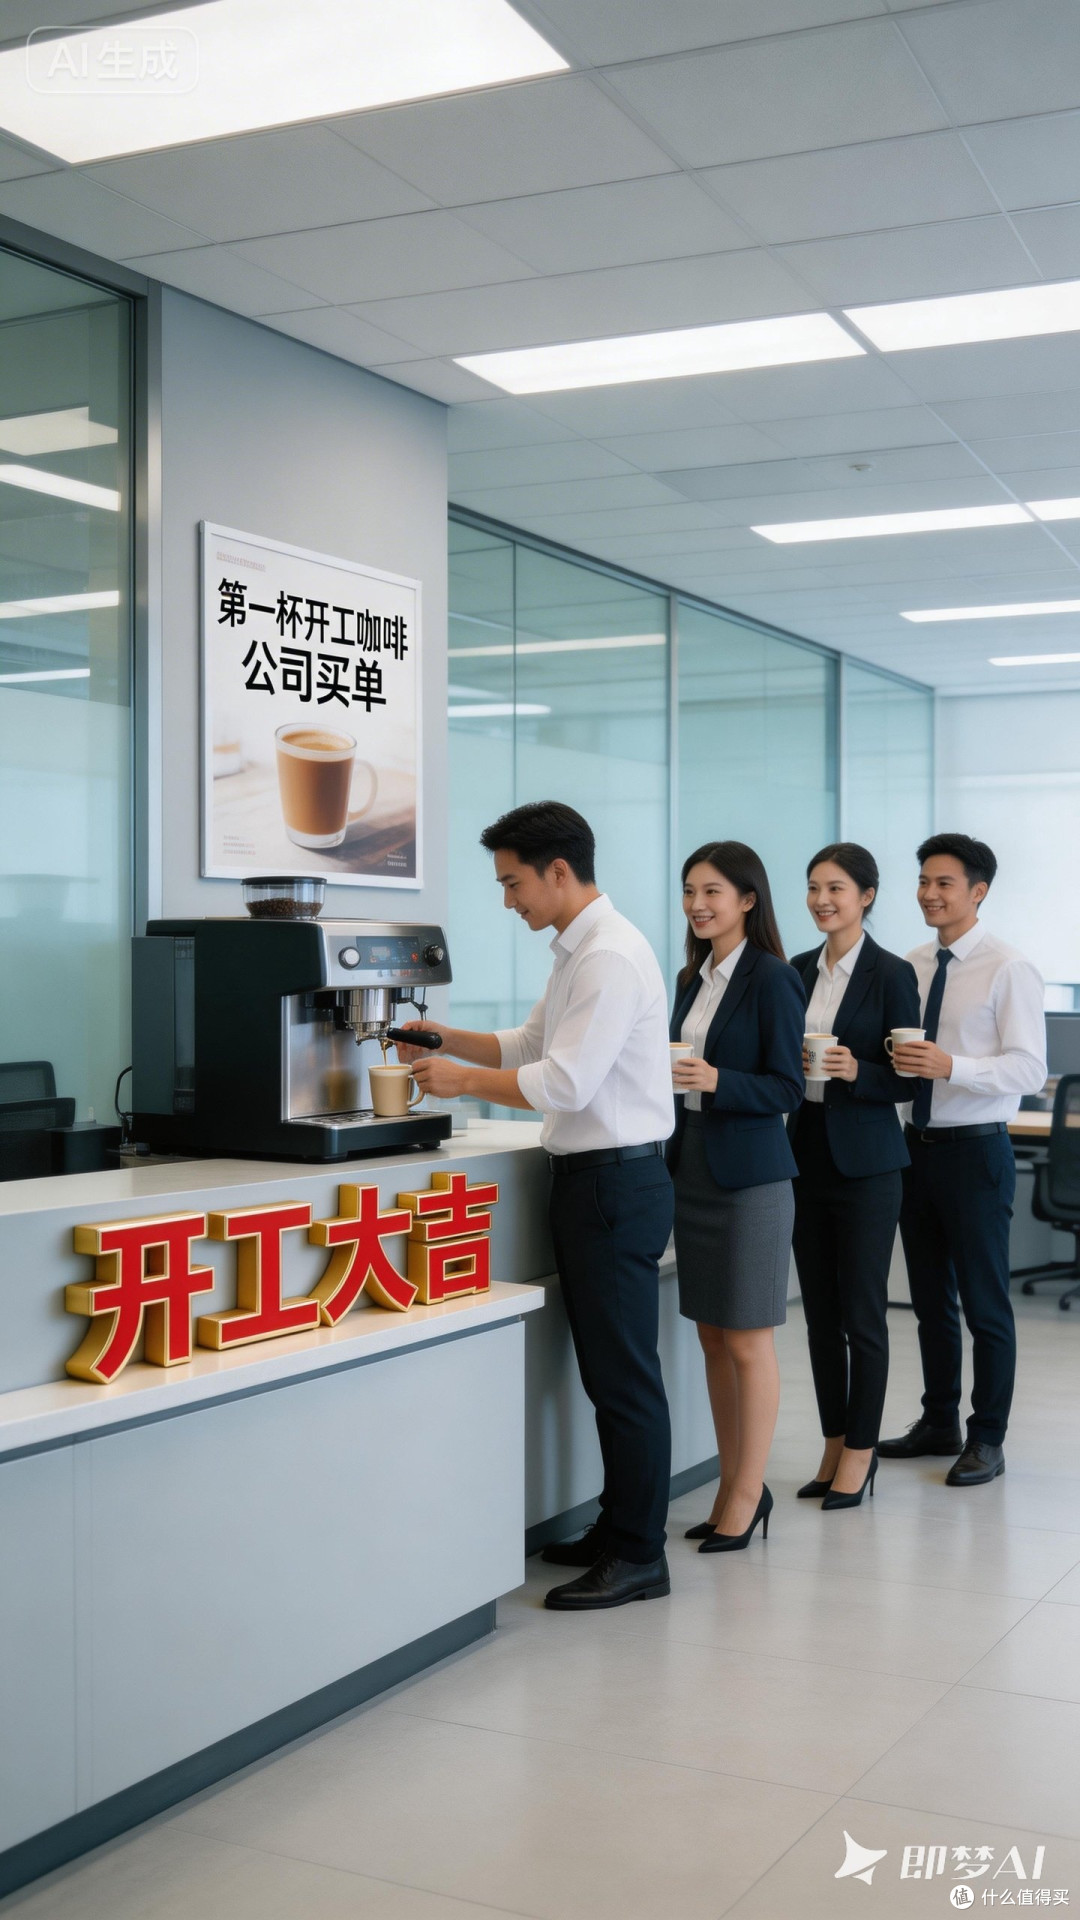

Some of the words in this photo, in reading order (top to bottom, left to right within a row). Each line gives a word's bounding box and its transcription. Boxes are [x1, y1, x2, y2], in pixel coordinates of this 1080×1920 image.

[217, 577, 409, 661] 第一杯开工咖啡
[241, 640, 387, 712] 公司买单
[66, 1171, 499, 1384] 开工大吉
